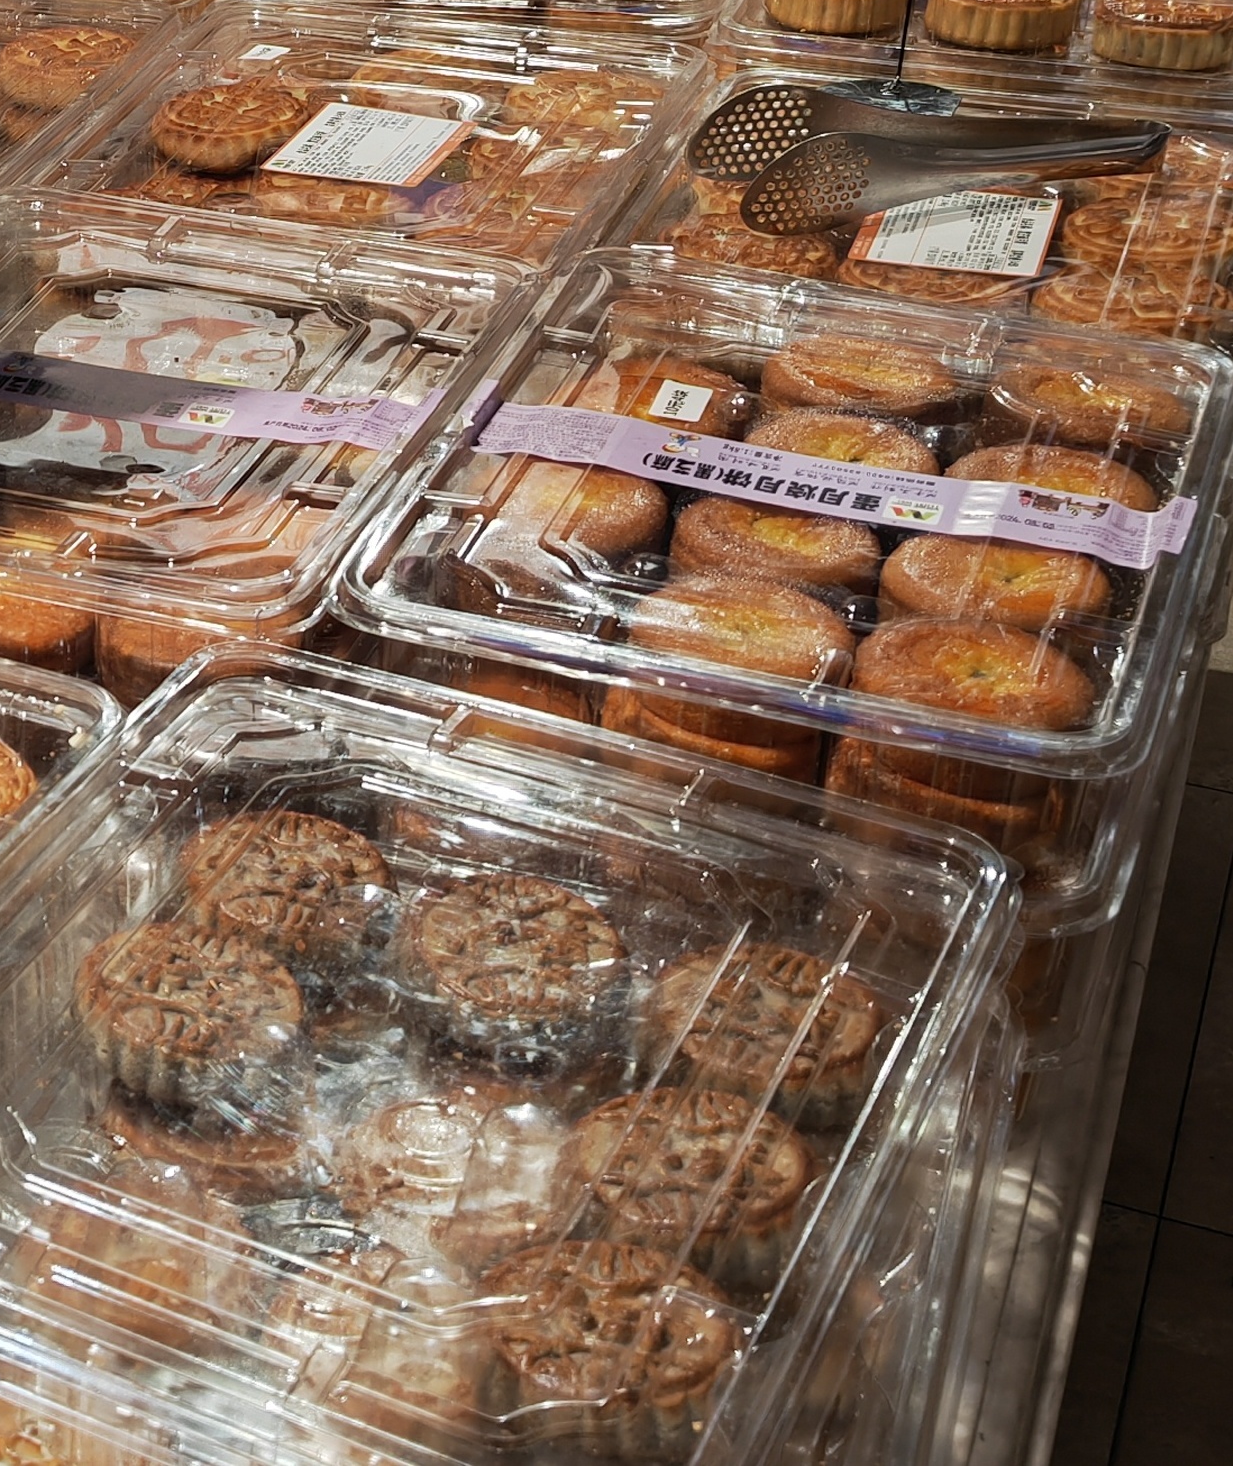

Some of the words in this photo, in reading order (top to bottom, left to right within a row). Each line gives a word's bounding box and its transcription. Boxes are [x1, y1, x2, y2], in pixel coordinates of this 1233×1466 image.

[642, 451, 883, 514] 蛋月烧月饼(黑芝麻)
